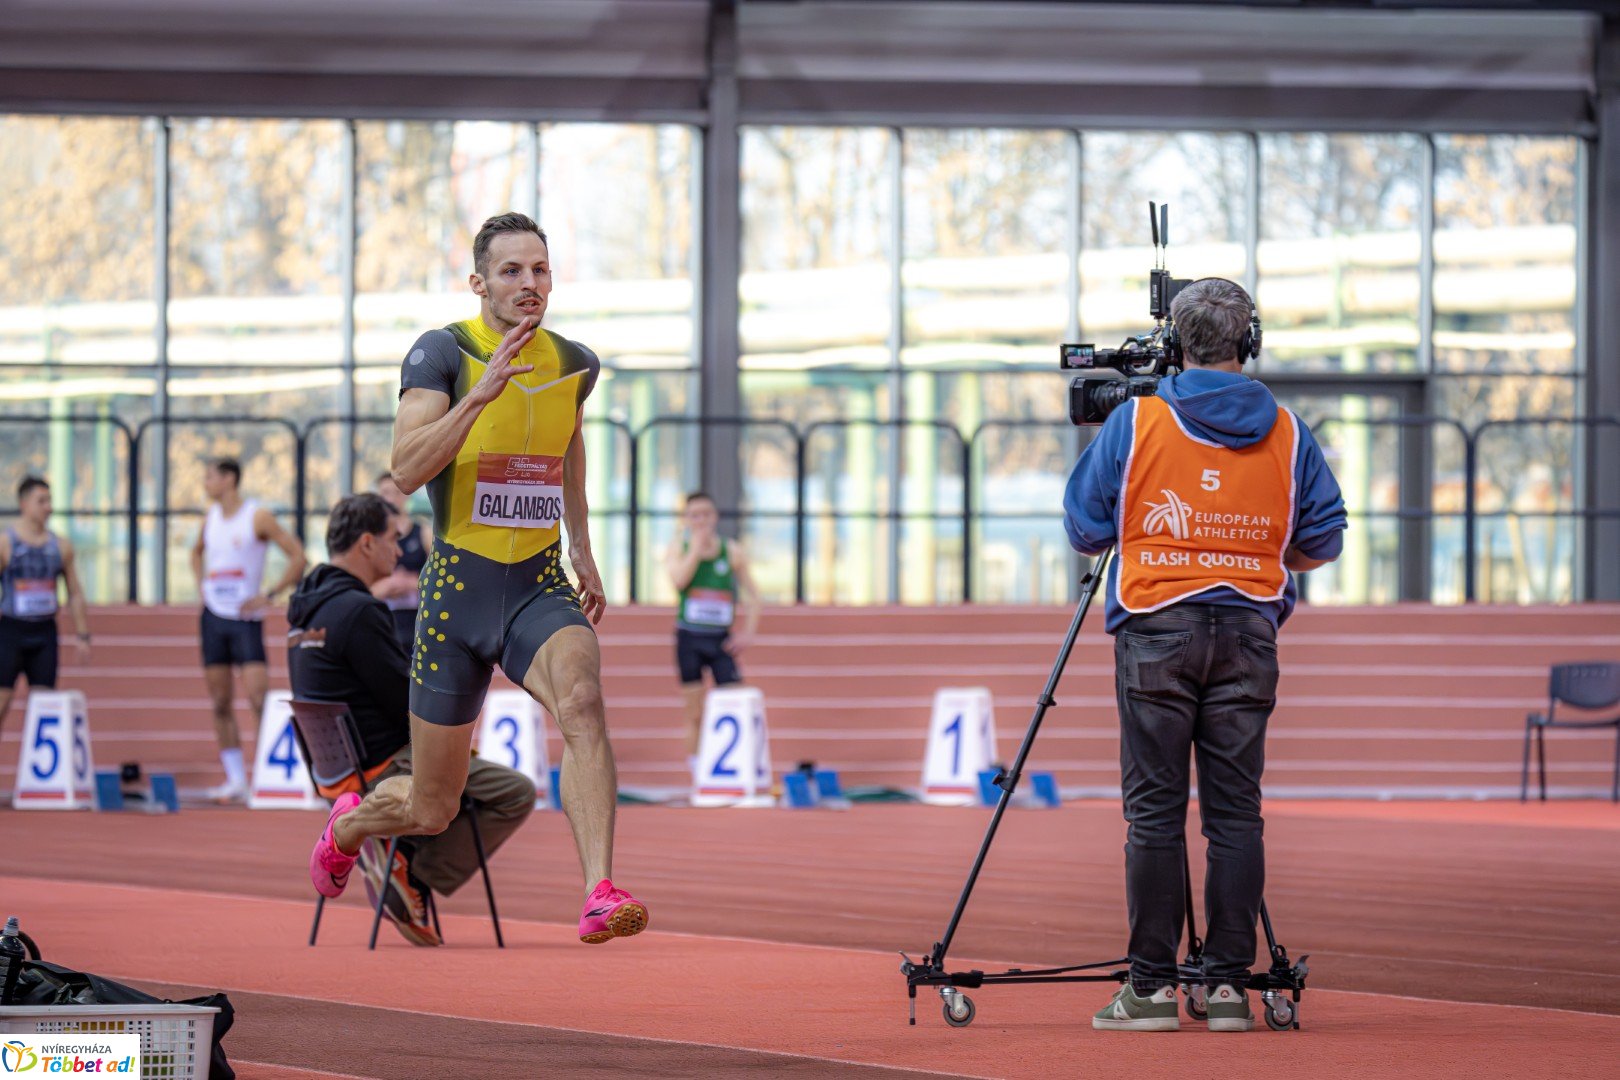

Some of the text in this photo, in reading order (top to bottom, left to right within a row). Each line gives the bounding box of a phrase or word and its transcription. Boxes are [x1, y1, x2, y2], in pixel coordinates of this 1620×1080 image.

[1200, 468, 1221, 491] 5
[479, 493, 561, 520] GALAMBOS
[1195, 512, 1271, 527] EUROPEAN
[1194, 526, 1269, 540] ATHLETICS
[1140, 551, 1261, 571] FLASH QUOTES
[31, 717, 59, 779] 5
[266, 722, 299, 780] 4
[493, 716, 520, 770] 3
[711, 715, 741, 776] 2
[943, 712, 963, 777] 1
